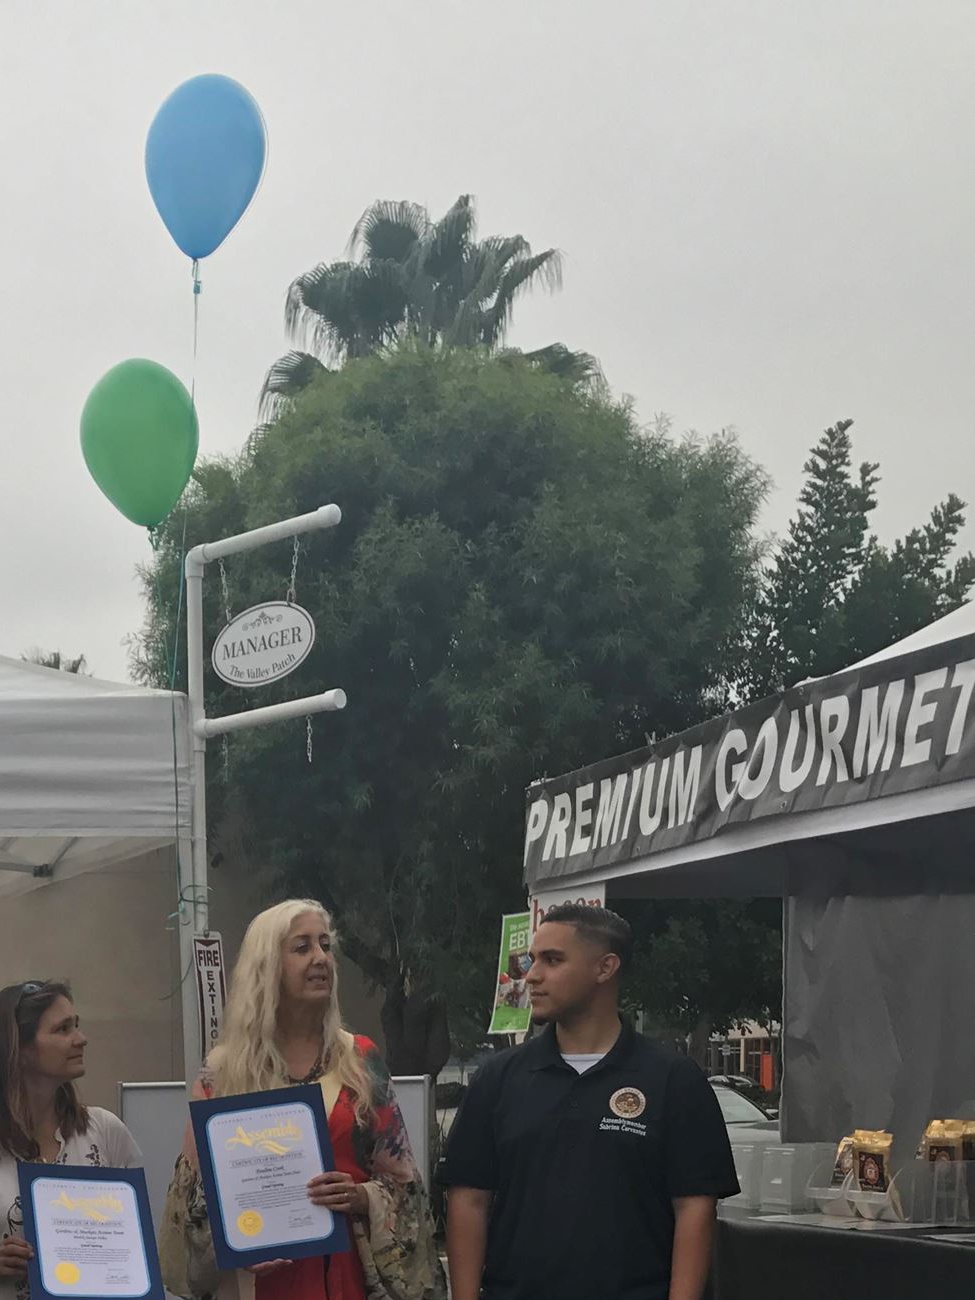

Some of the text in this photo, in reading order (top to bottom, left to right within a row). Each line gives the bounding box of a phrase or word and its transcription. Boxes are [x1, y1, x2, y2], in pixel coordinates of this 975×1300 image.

[222, 626, 302, 661] MANAGER
[229, 653, 296, 679] The Valley Patch
[523, 659, 975, 868] PREMIUM GOURMET
[197, 949, 220, 967] FIRE
[599, 1123, 620, 1131] Sabrina
